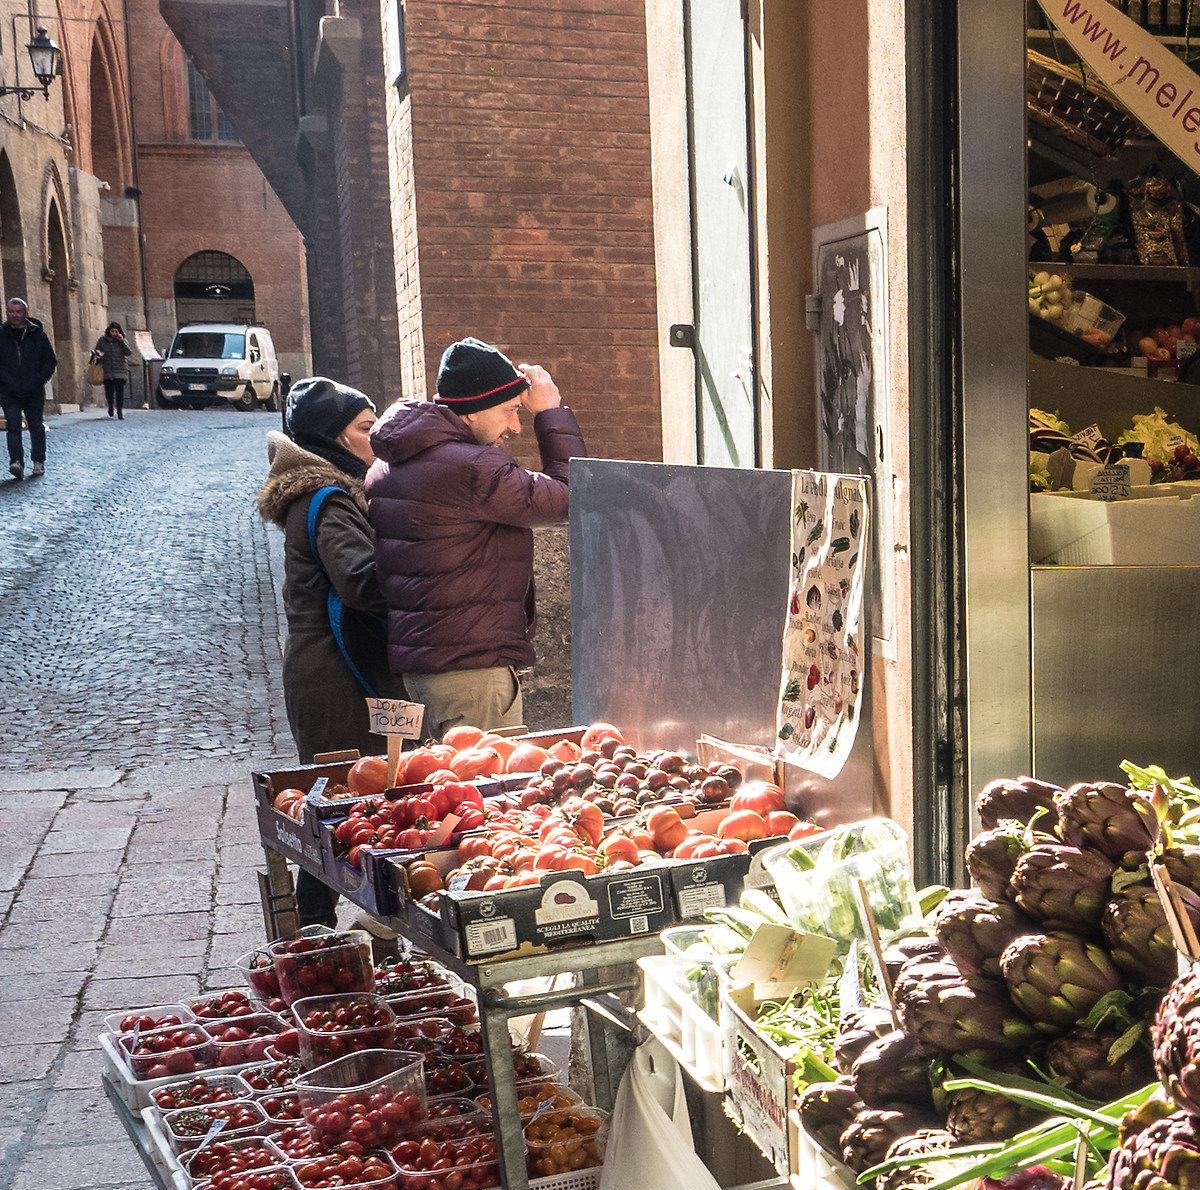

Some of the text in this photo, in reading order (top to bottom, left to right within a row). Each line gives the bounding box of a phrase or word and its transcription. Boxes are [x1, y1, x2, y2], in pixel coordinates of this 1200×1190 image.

[372, 712, 420, 728] TOUCH!
[536, 924, 561, 934] SCEGLI
[543, 925, 596, 938] MEDITERRANEA
